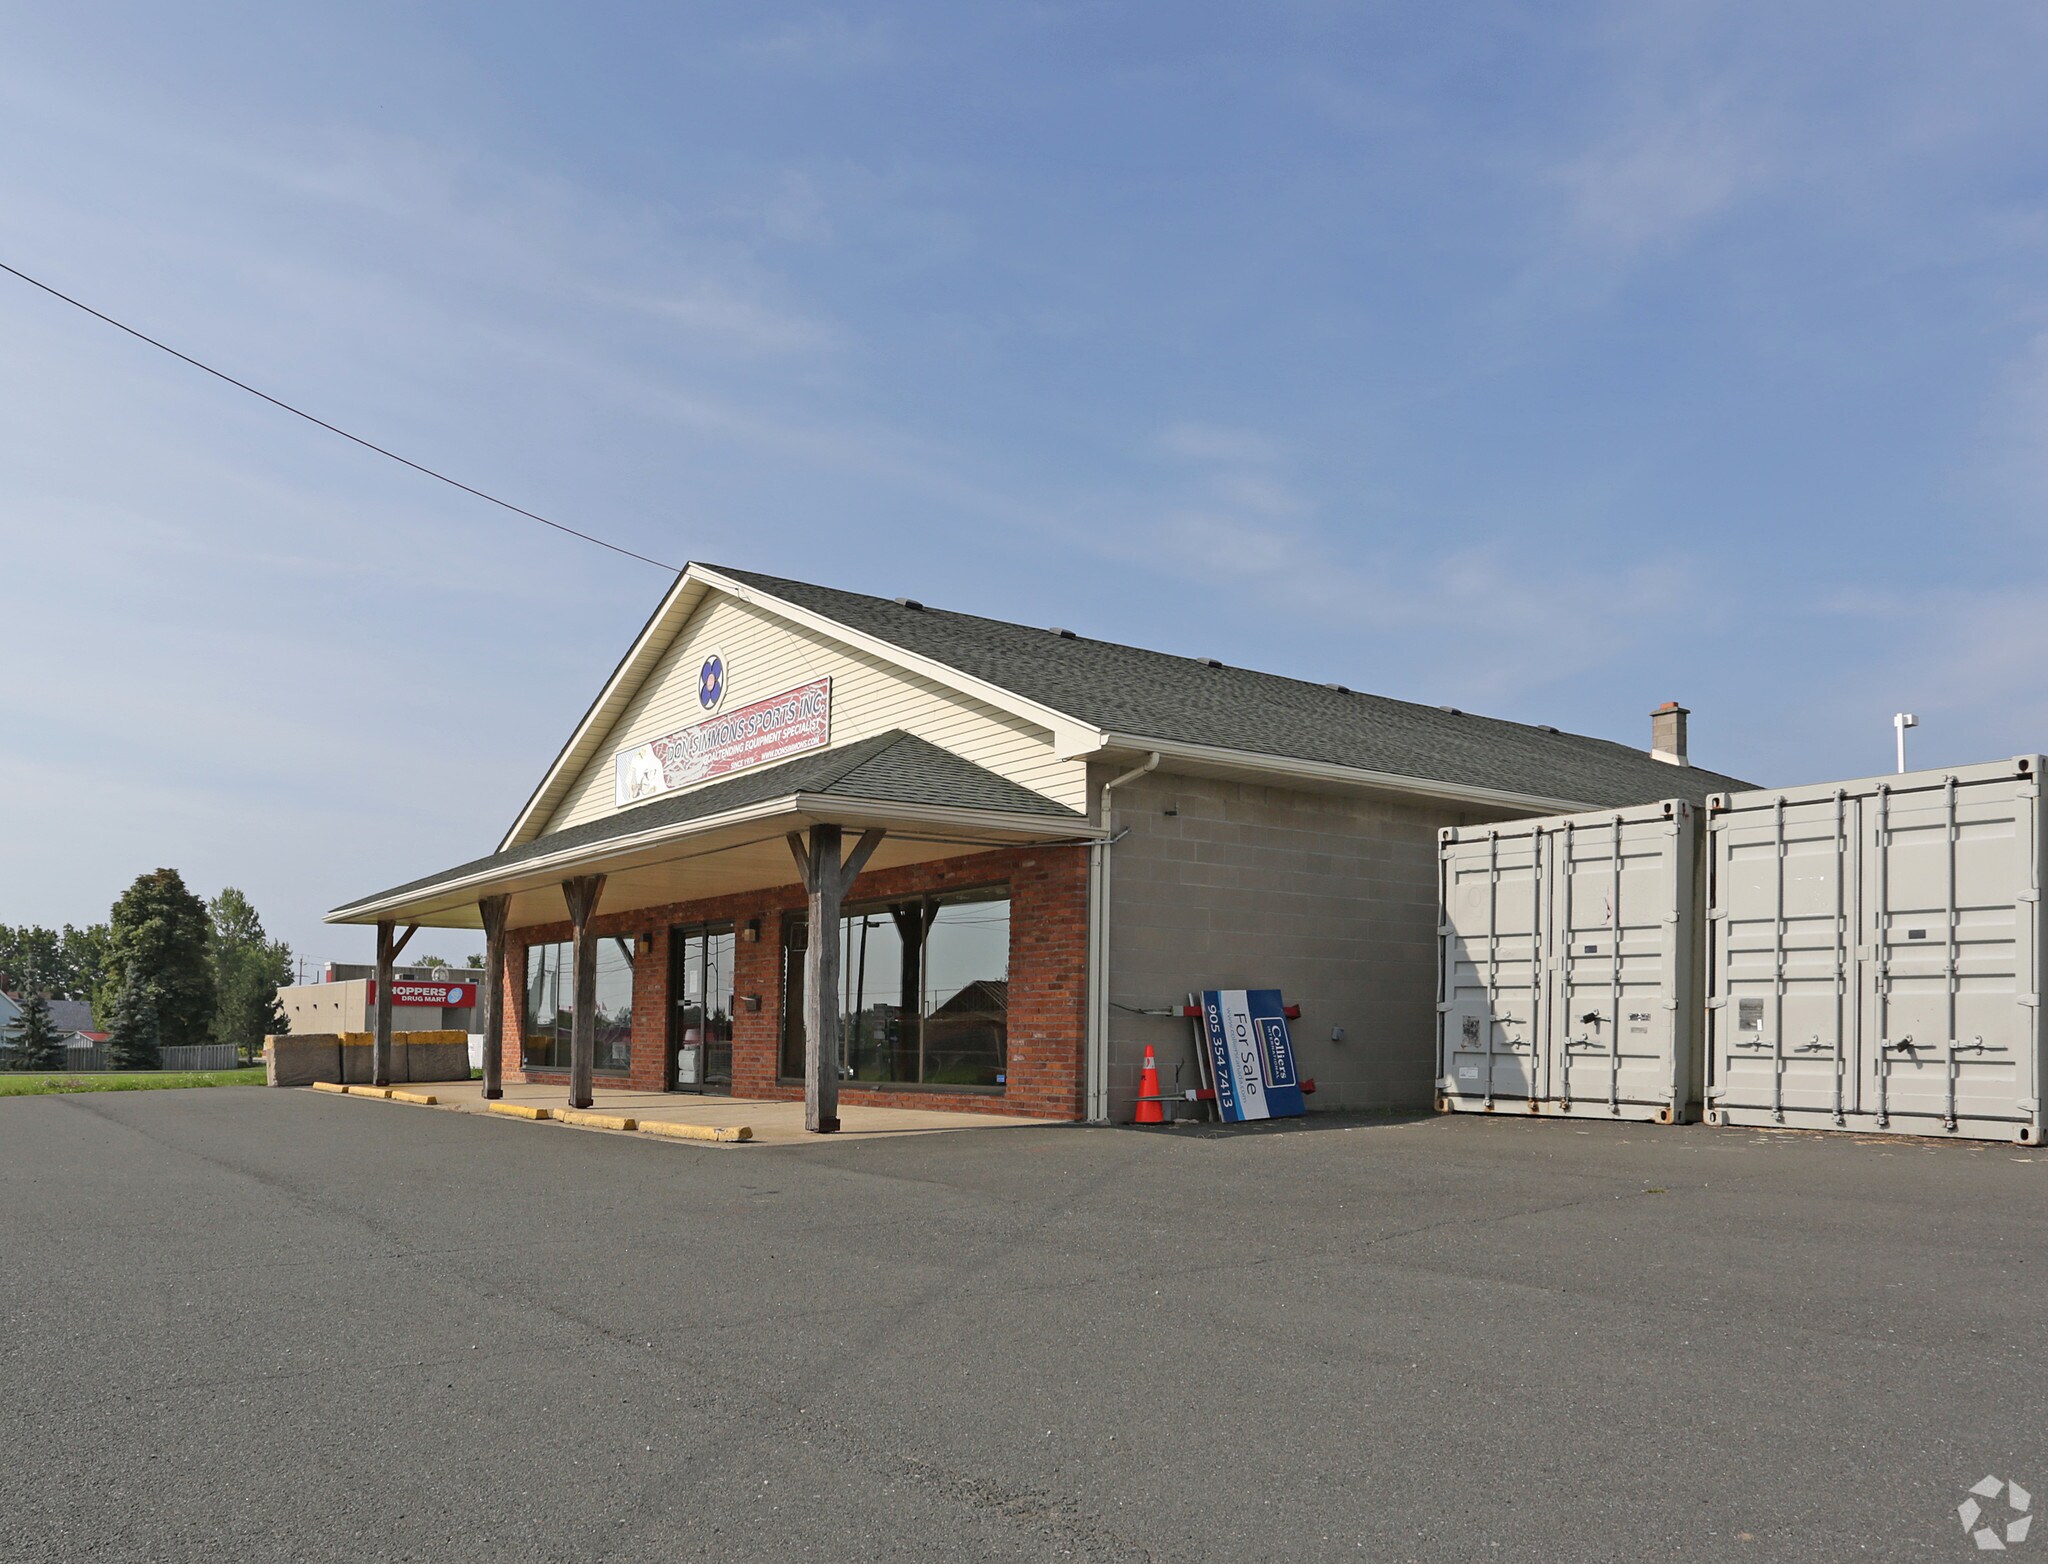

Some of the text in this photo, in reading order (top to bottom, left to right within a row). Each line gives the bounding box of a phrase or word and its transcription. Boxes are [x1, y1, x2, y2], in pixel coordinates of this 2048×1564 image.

[667, 692, 825, 761] DON SIMMONS SPORTS INC.
[703, 719, 819, 764] GOALTENDING EQUIPMENT SPECIALIST
[761, 736, 820, 760] WWW.DONSIMMONS.COM
[392, 986, 446, 996] HOPPERS
[1208, 1005, 1233, 1108] 905 354 7413
[1226, 1008, 1247, 1103] www.collierscanada.com
[1234, 1013, 1258, 1095] For Sale
[1267, 1025, 1280, 1079] INTERNATIONAL
[1272, 1025, 1287, 1079] Colliers
